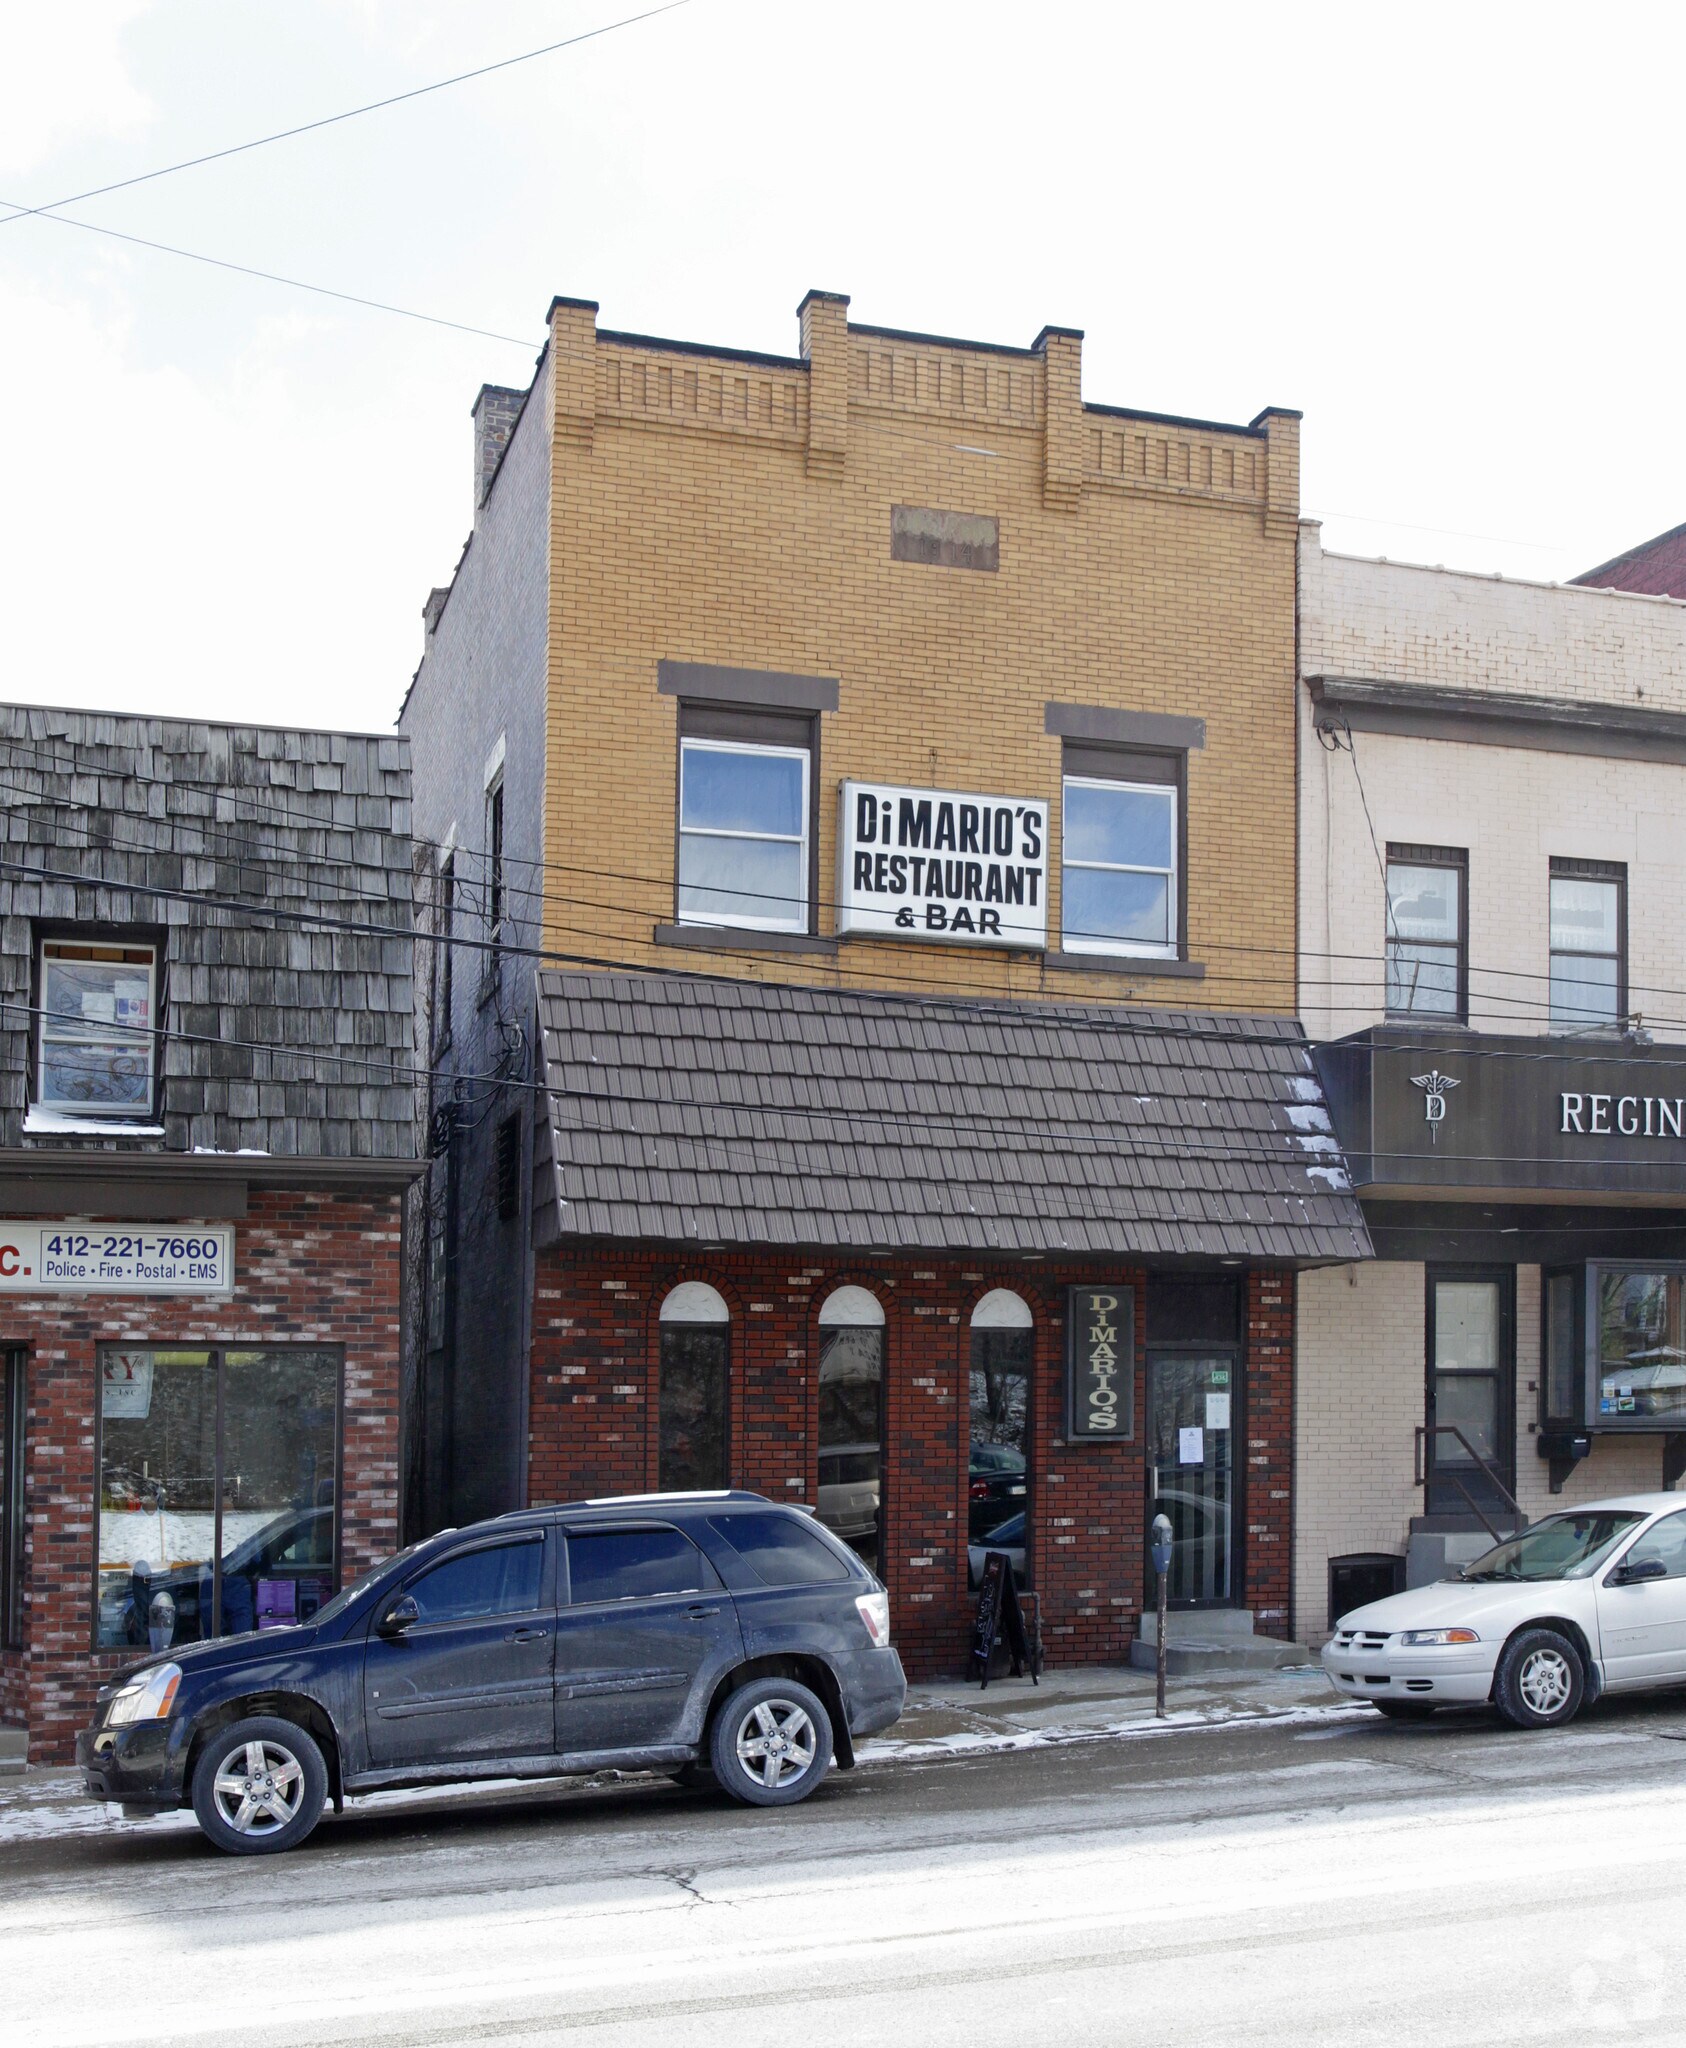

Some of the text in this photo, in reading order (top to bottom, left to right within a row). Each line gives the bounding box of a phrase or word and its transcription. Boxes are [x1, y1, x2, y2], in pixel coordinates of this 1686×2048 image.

[856, 793, 1042, 859] DiMARIO'S
[854, 851, 1042, 906] RESTAURANT
[895, 903, 1003, 936] & BAR
[46, 1236, 218, 1259] 412-221-7660
[46, 1261, 218, 1279] Police Fire Postal EMS
